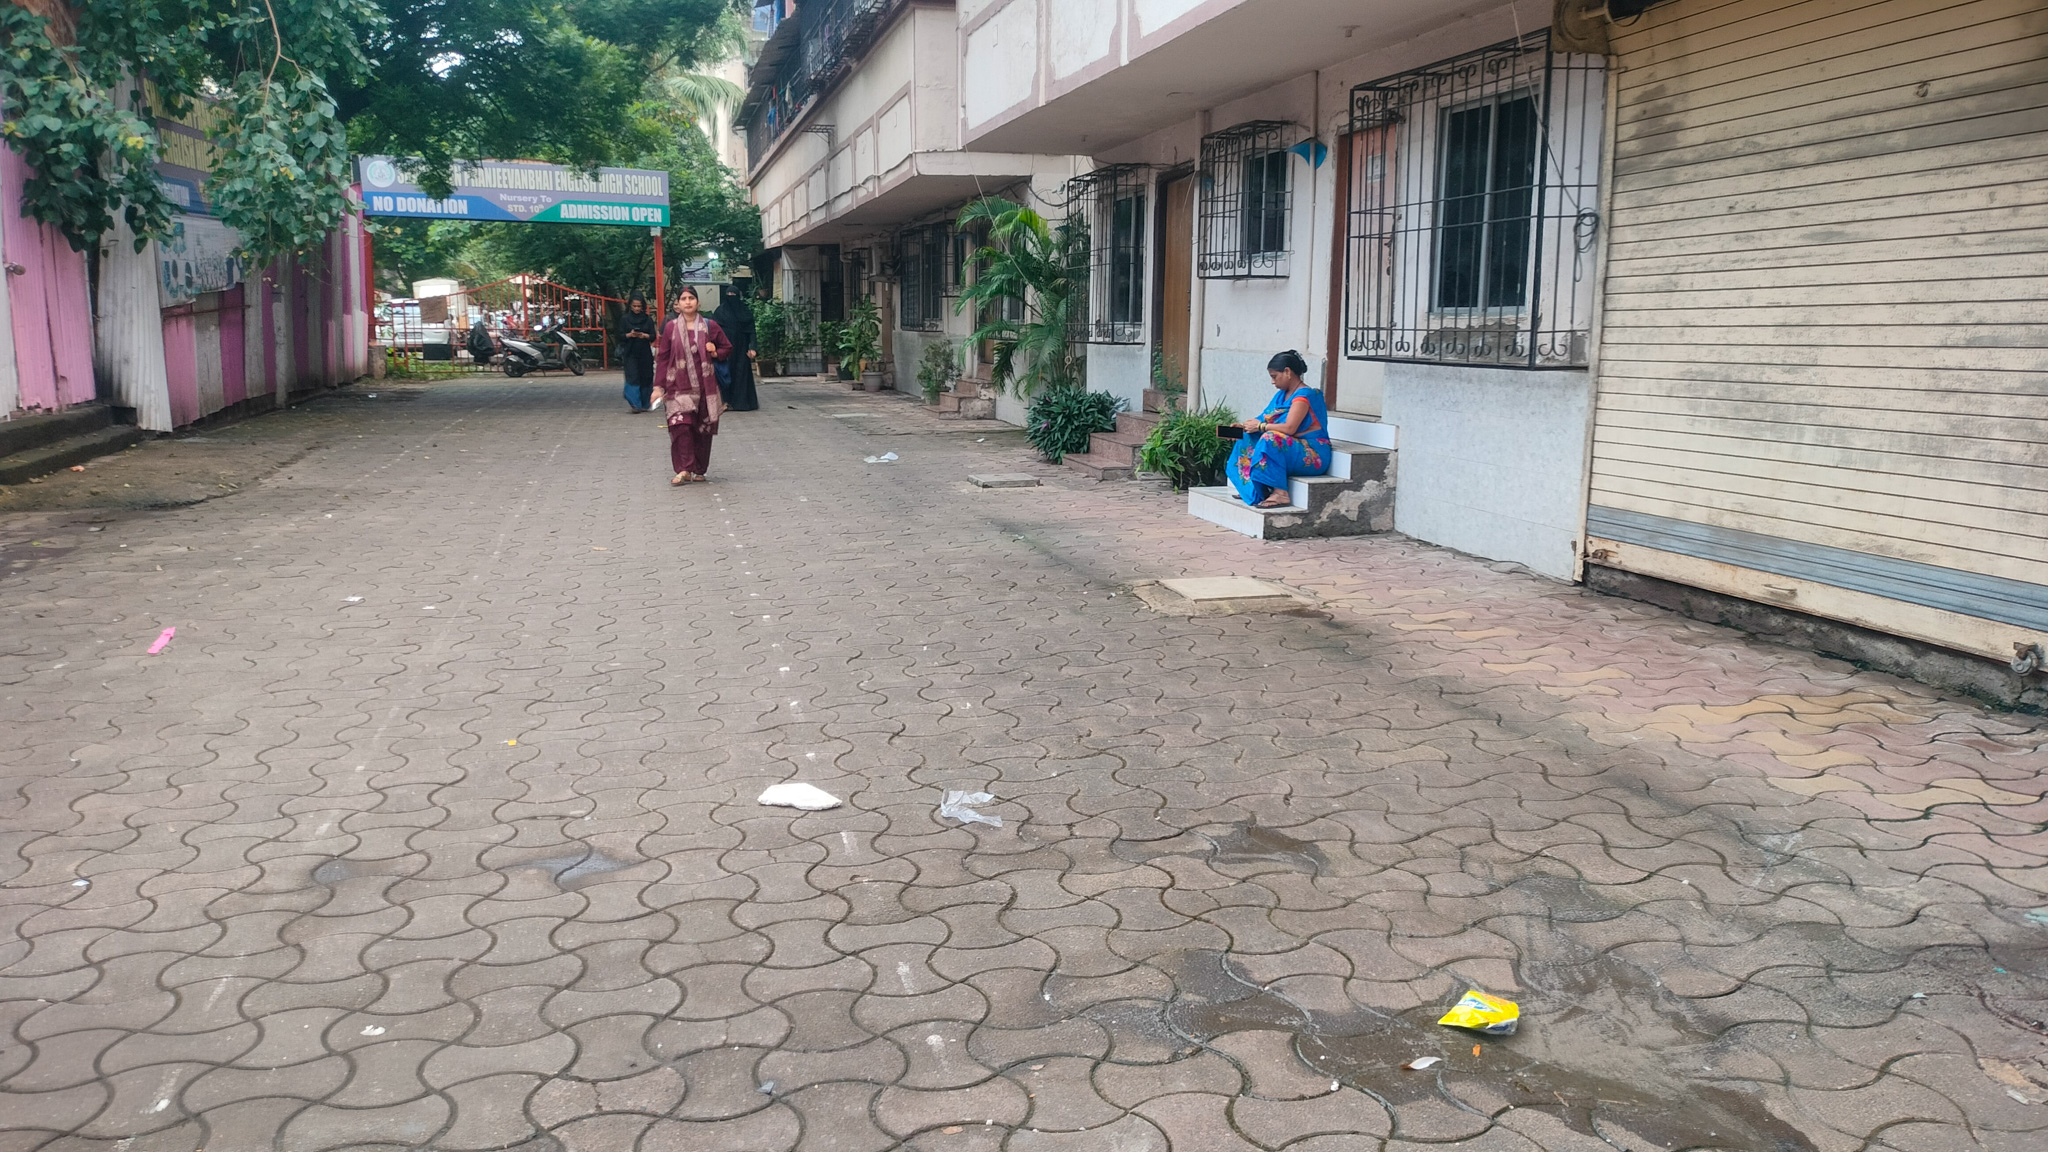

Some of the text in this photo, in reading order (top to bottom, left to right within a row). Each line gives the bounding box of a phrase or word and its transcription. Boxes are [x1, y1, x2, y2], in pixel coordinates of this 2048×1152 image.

[599, 173, 623, 194] HIGH
[624, 174, 664, 197] SCHOOL
[373, 195, 394, 212] NO
[499, 193, 553, 204] Nursery To
[507, 203, 527, 213] STD.
[560, 203, 663, 223] ADMISSION OPEN
